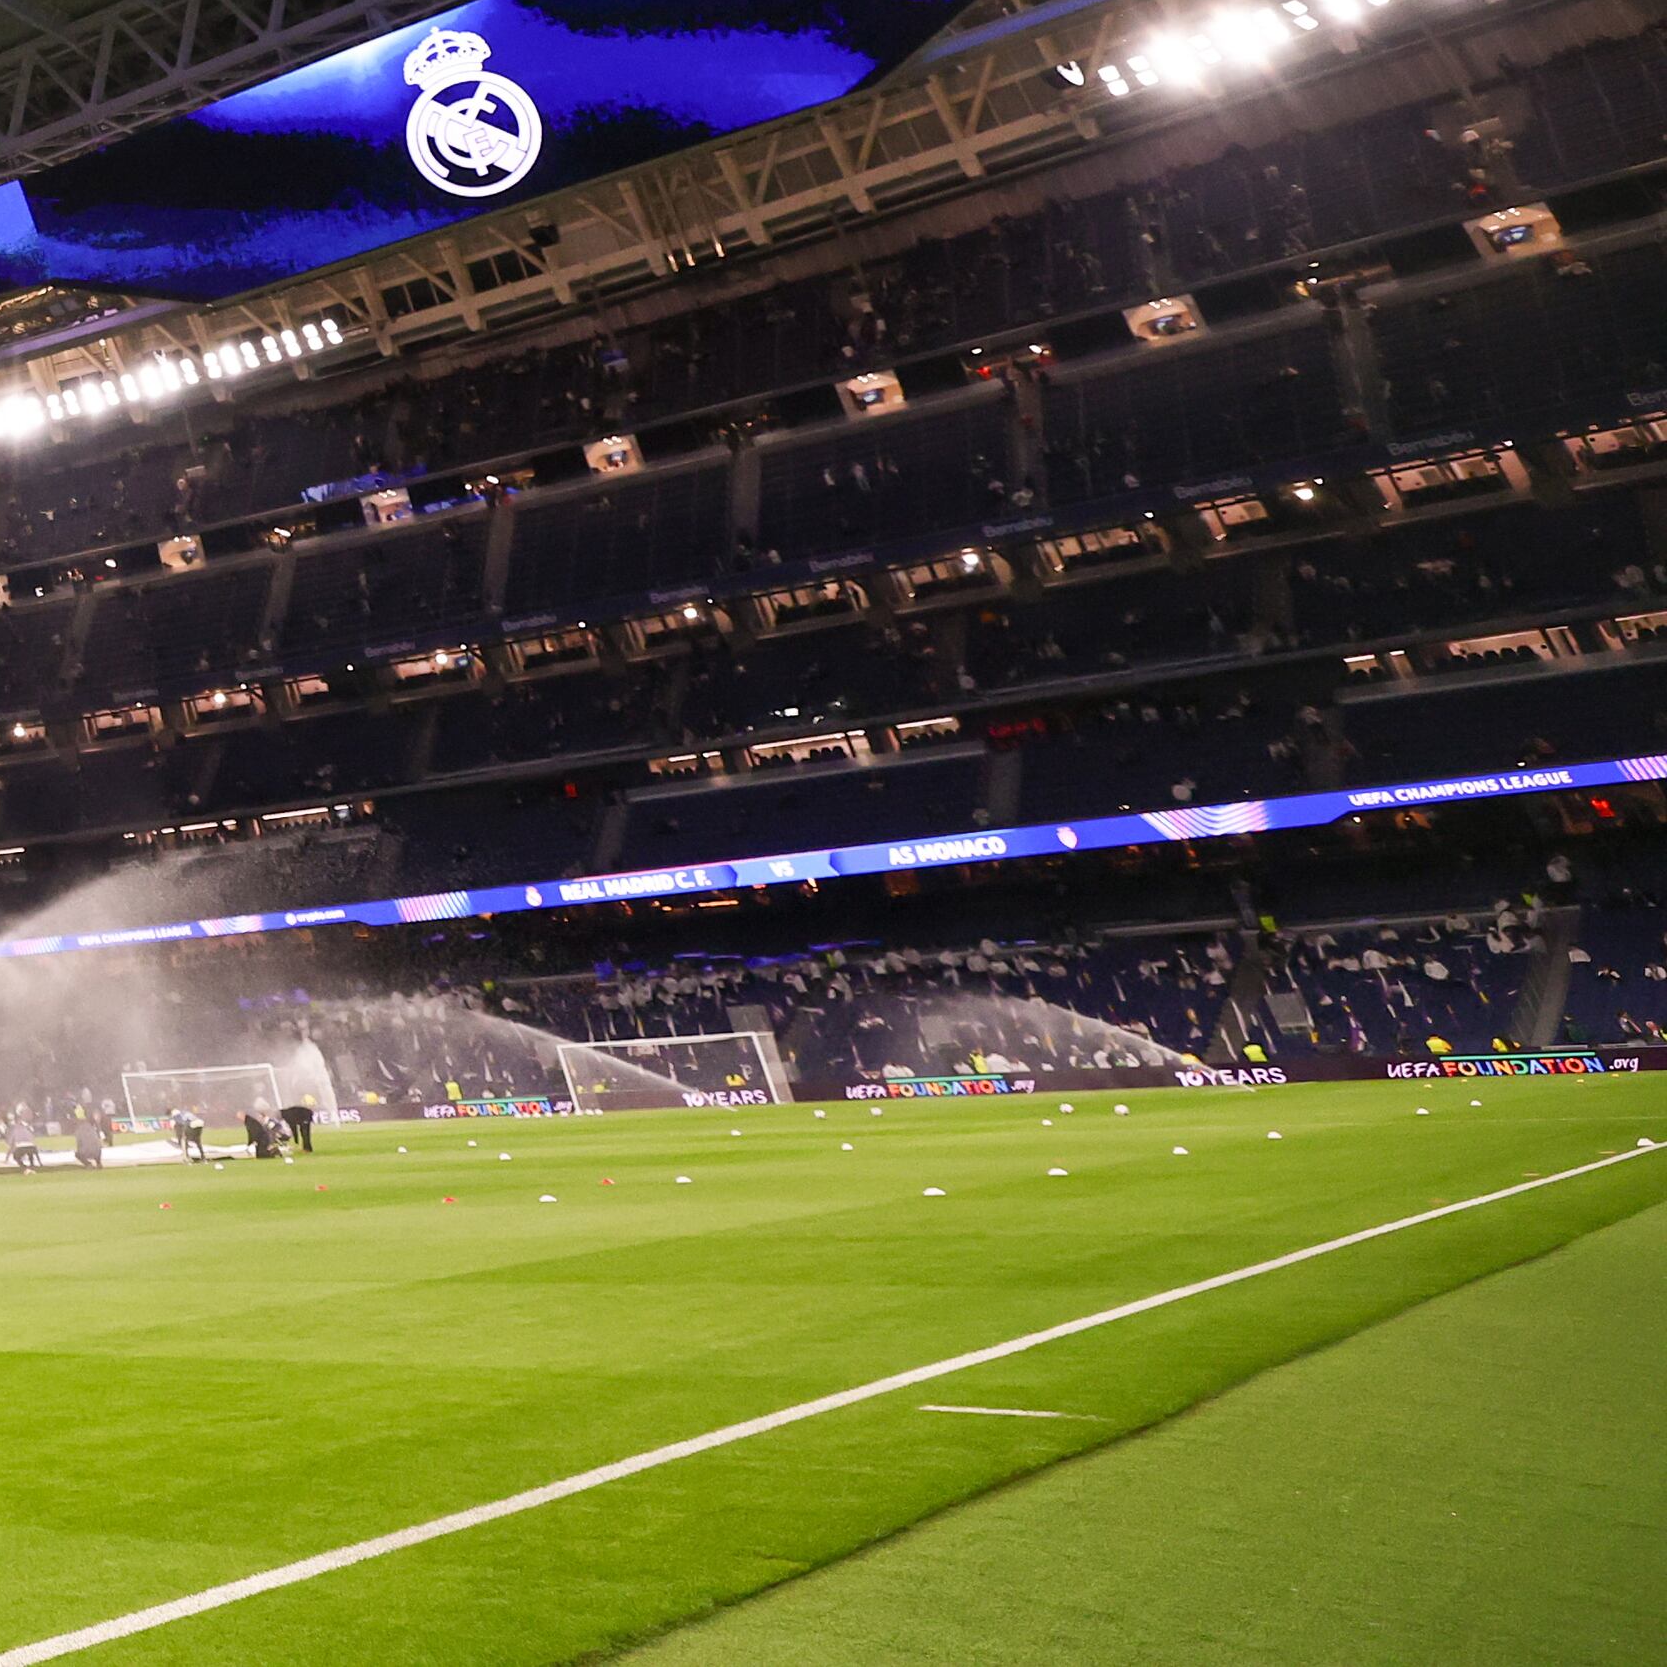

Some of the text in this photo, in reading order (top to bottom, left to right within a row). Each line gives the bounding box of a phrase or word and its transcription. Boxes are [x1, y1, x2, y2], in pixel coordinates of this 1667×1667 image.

[1348, 769, 1573, 808] UEFA CHAMPIONS LEAGUE
[889, 835, 1007, 866] AS MONACO
[769, 860, 794, 878] VS
[559, 883, 606, 902] REAL
[607, 873, 675, 897] MADRID
[1387, 1056, 1639, 1080] UEFA FOUNDATION .org
[845, 1084, 887, 1101] UEFA
[888, 1079, 1009, 1099] FOUNDATION
[457, 1101, 553, 1117] FOUNDATION
